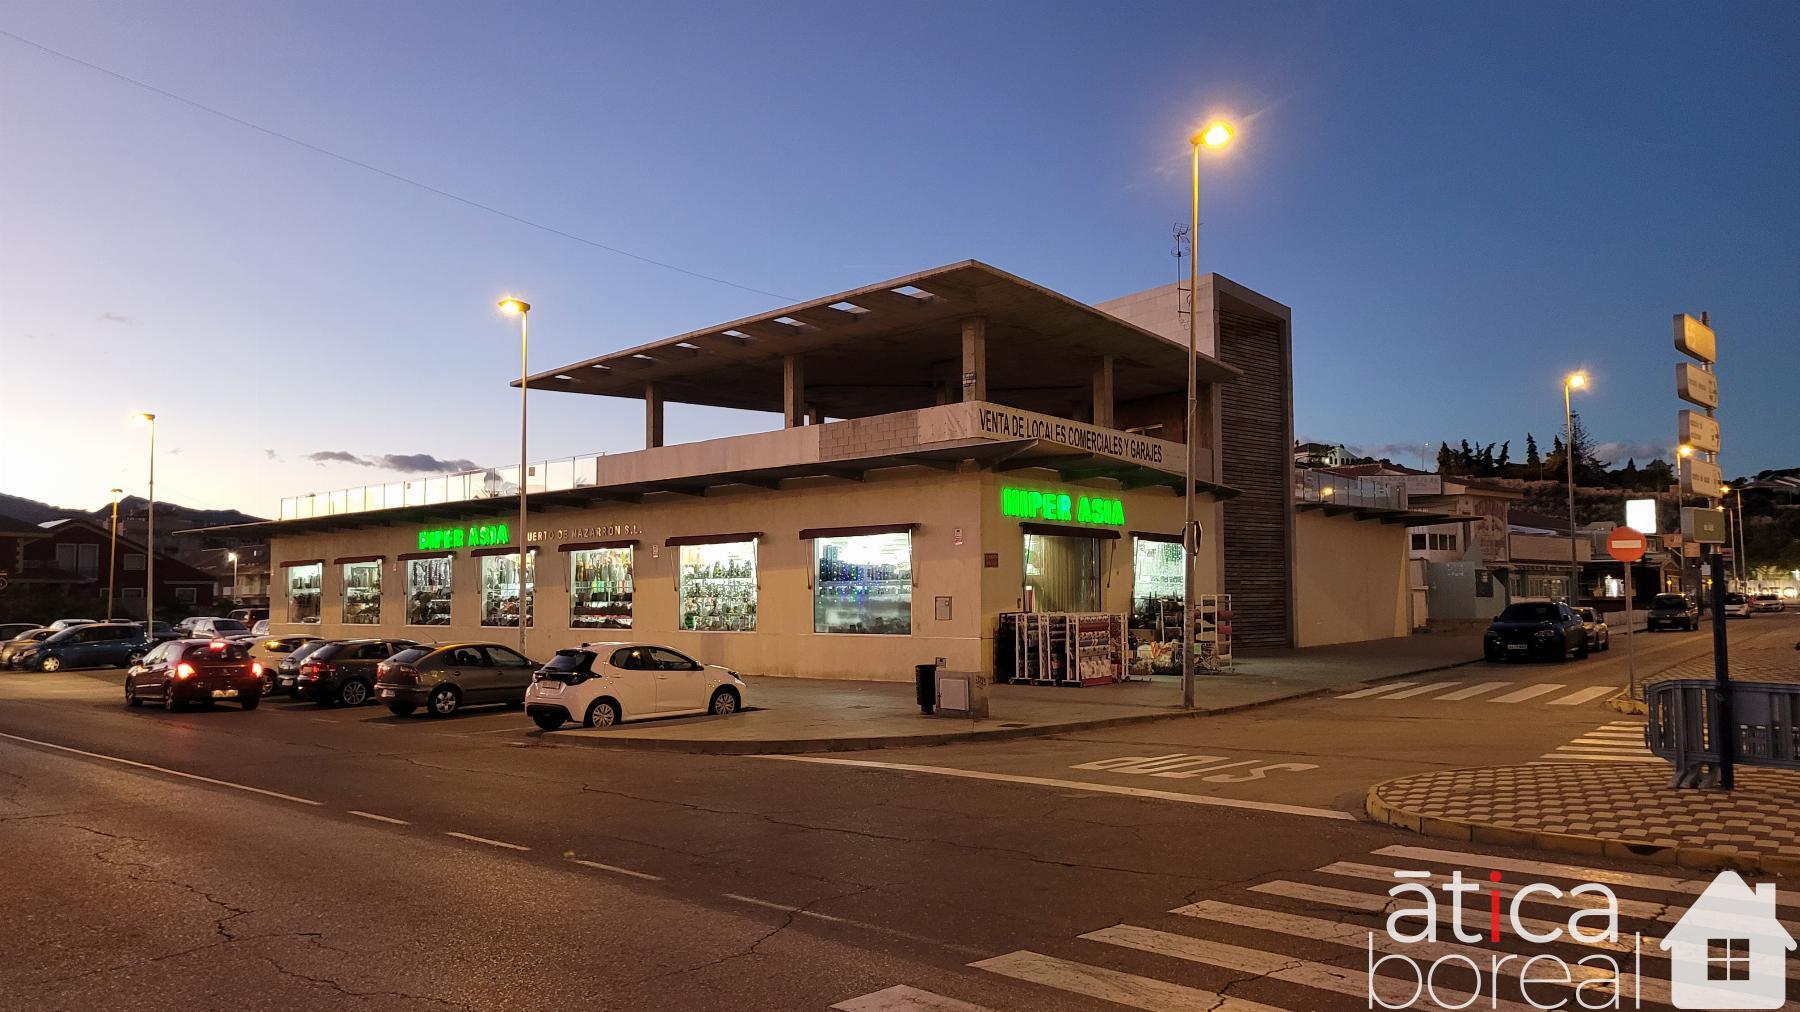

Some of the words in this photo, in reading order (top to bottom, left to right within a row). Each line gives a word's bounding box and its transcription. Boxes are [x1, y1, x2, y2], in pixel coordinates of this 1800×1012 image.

[979, 408, 1010, 436] VENTA
[1012, 415, 1025, 438] DE
[1026, 418, 1067, 444] LOCALES
[1068, 426, 1123, 456] COMERCIALES
[1124, 438, 1129, 457] Y
[1130, 439, 1163, 463] GARAJES
[1002, 488, 1072, 521] HIPER
[1077, 495, 1125, 526] ASIA
[467, 523, 509, 547] ASIA
[527, 530, 555, 542] UERTO
